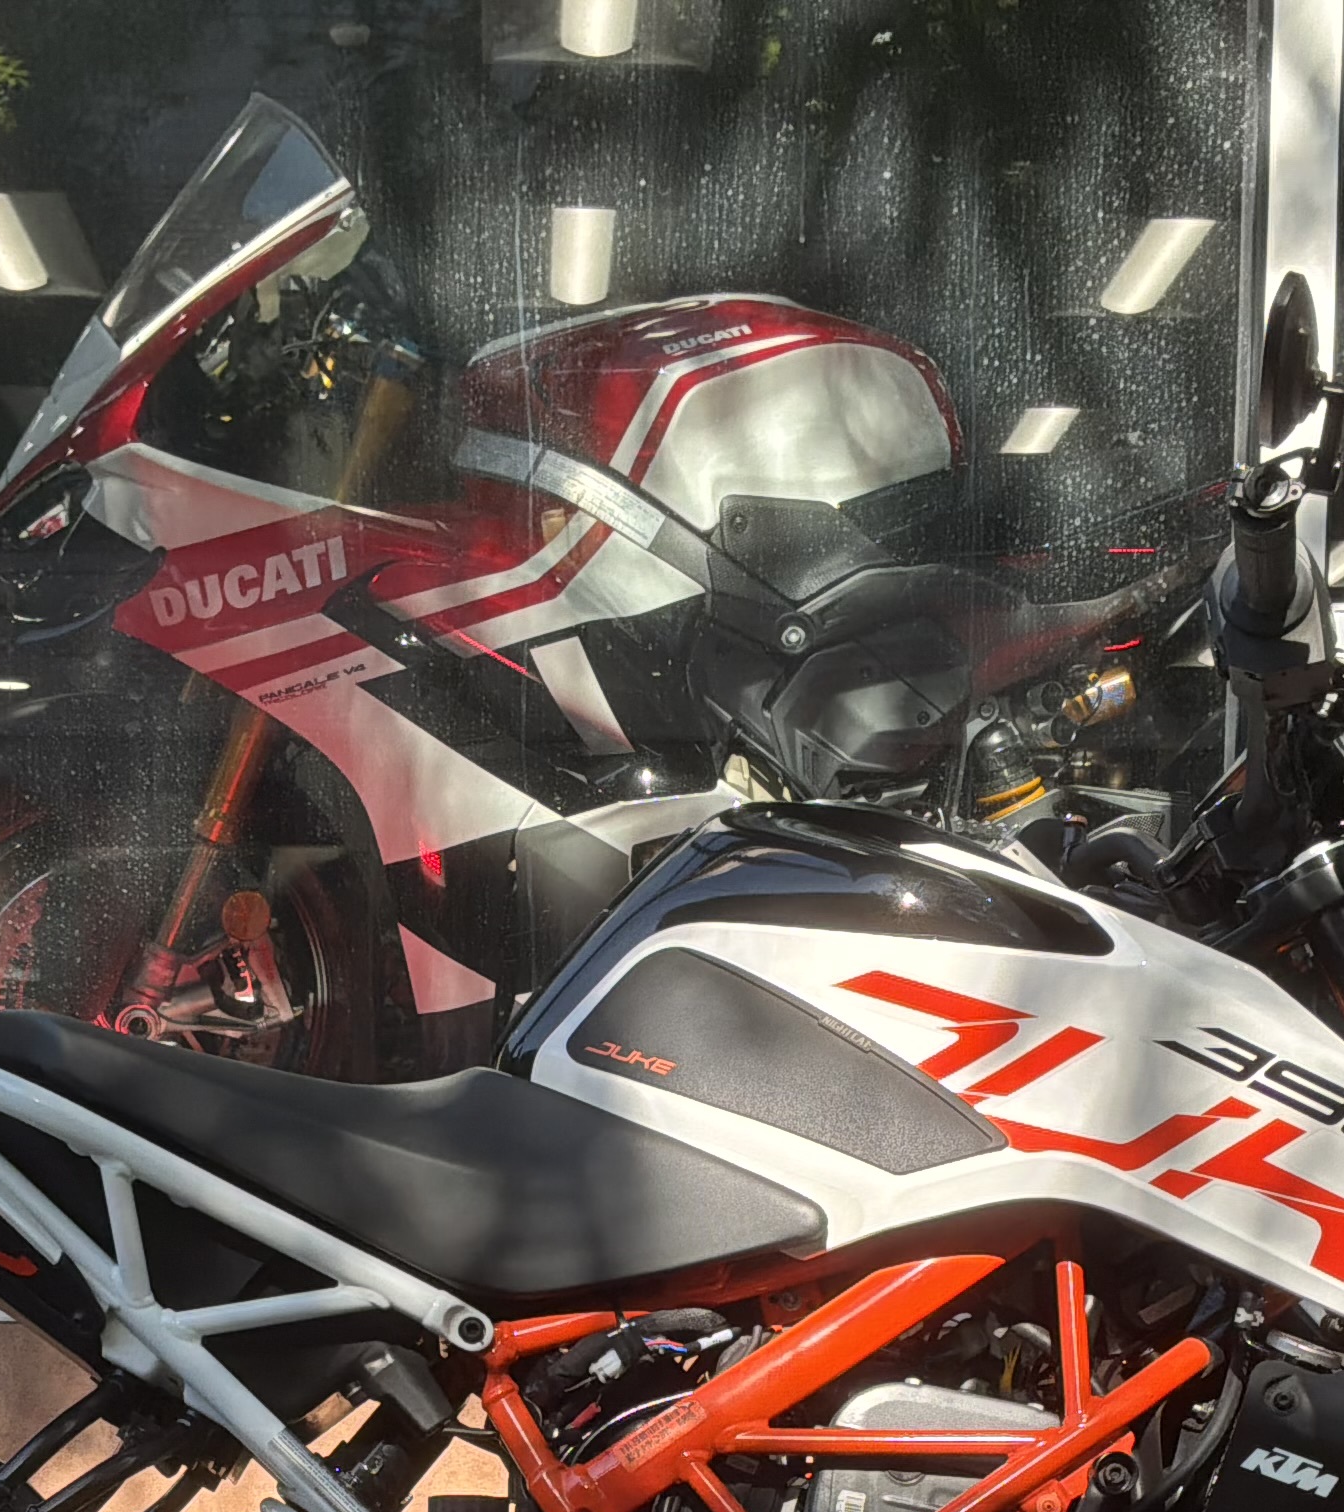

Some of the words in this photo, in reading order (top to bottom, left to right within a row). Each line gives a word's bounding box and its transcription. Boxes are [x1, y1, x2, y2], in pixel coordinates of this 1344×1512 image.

[662, 323, 753, 355] DUCATI
[149, 535, 347, 627] DUCATI
[584, 1041, 678, 1077] DUKE
[1240, 1446, 1340, 1498] KTM
